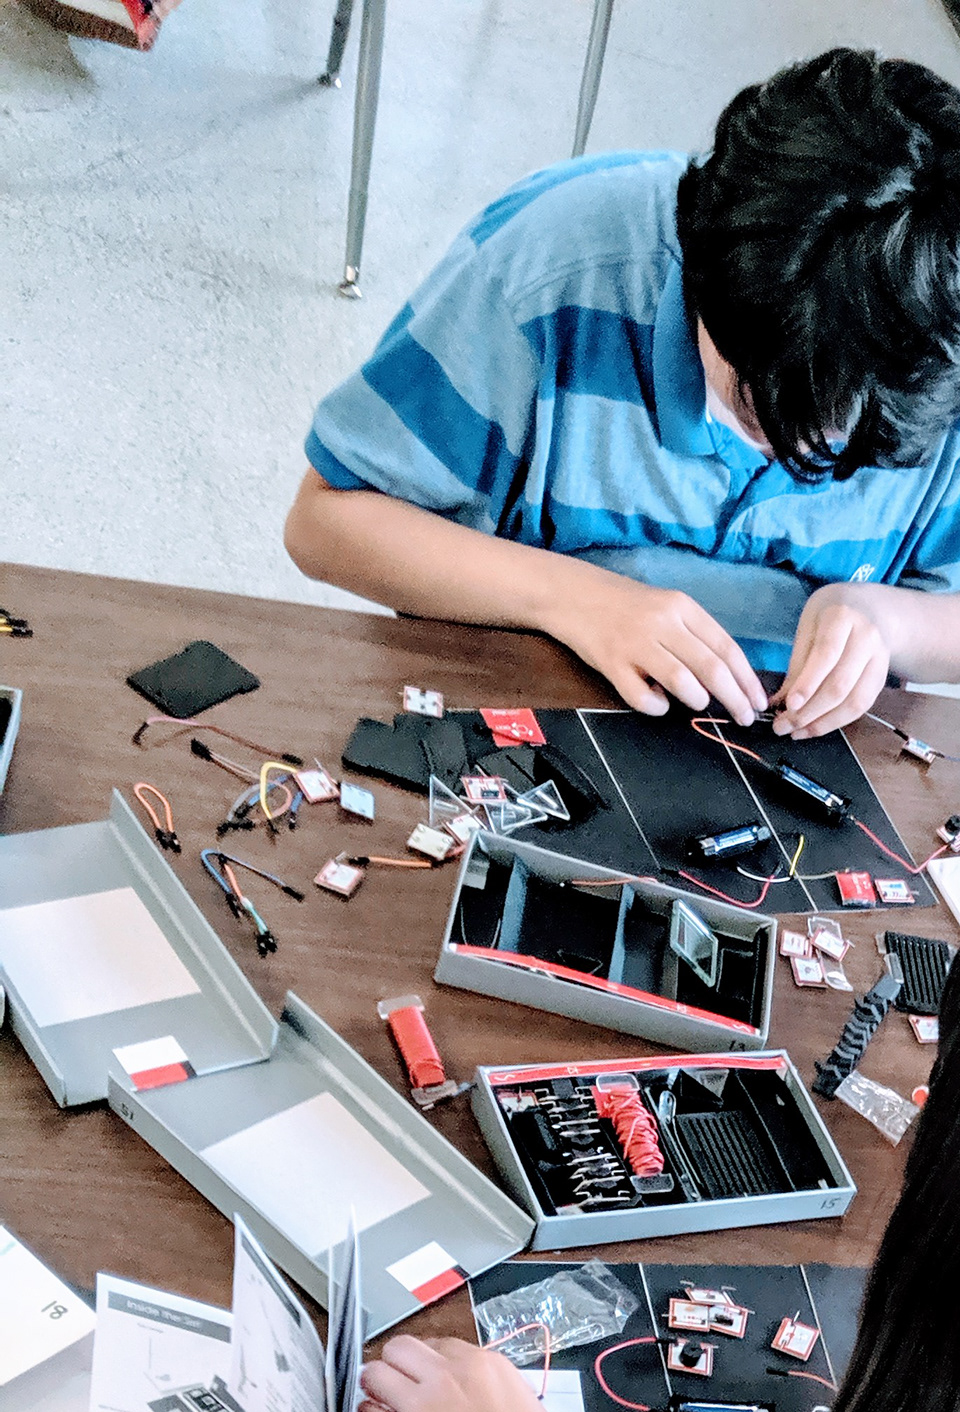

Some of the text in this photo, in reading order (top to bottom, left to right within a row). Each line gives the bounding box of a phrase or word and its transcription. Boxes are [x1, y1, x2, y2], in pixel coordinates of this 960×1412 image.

[820, 1197, 842, 1209] 15
[41, 1300, 68, 1320] 18
[127, 1299, 161, 1317] Inside
